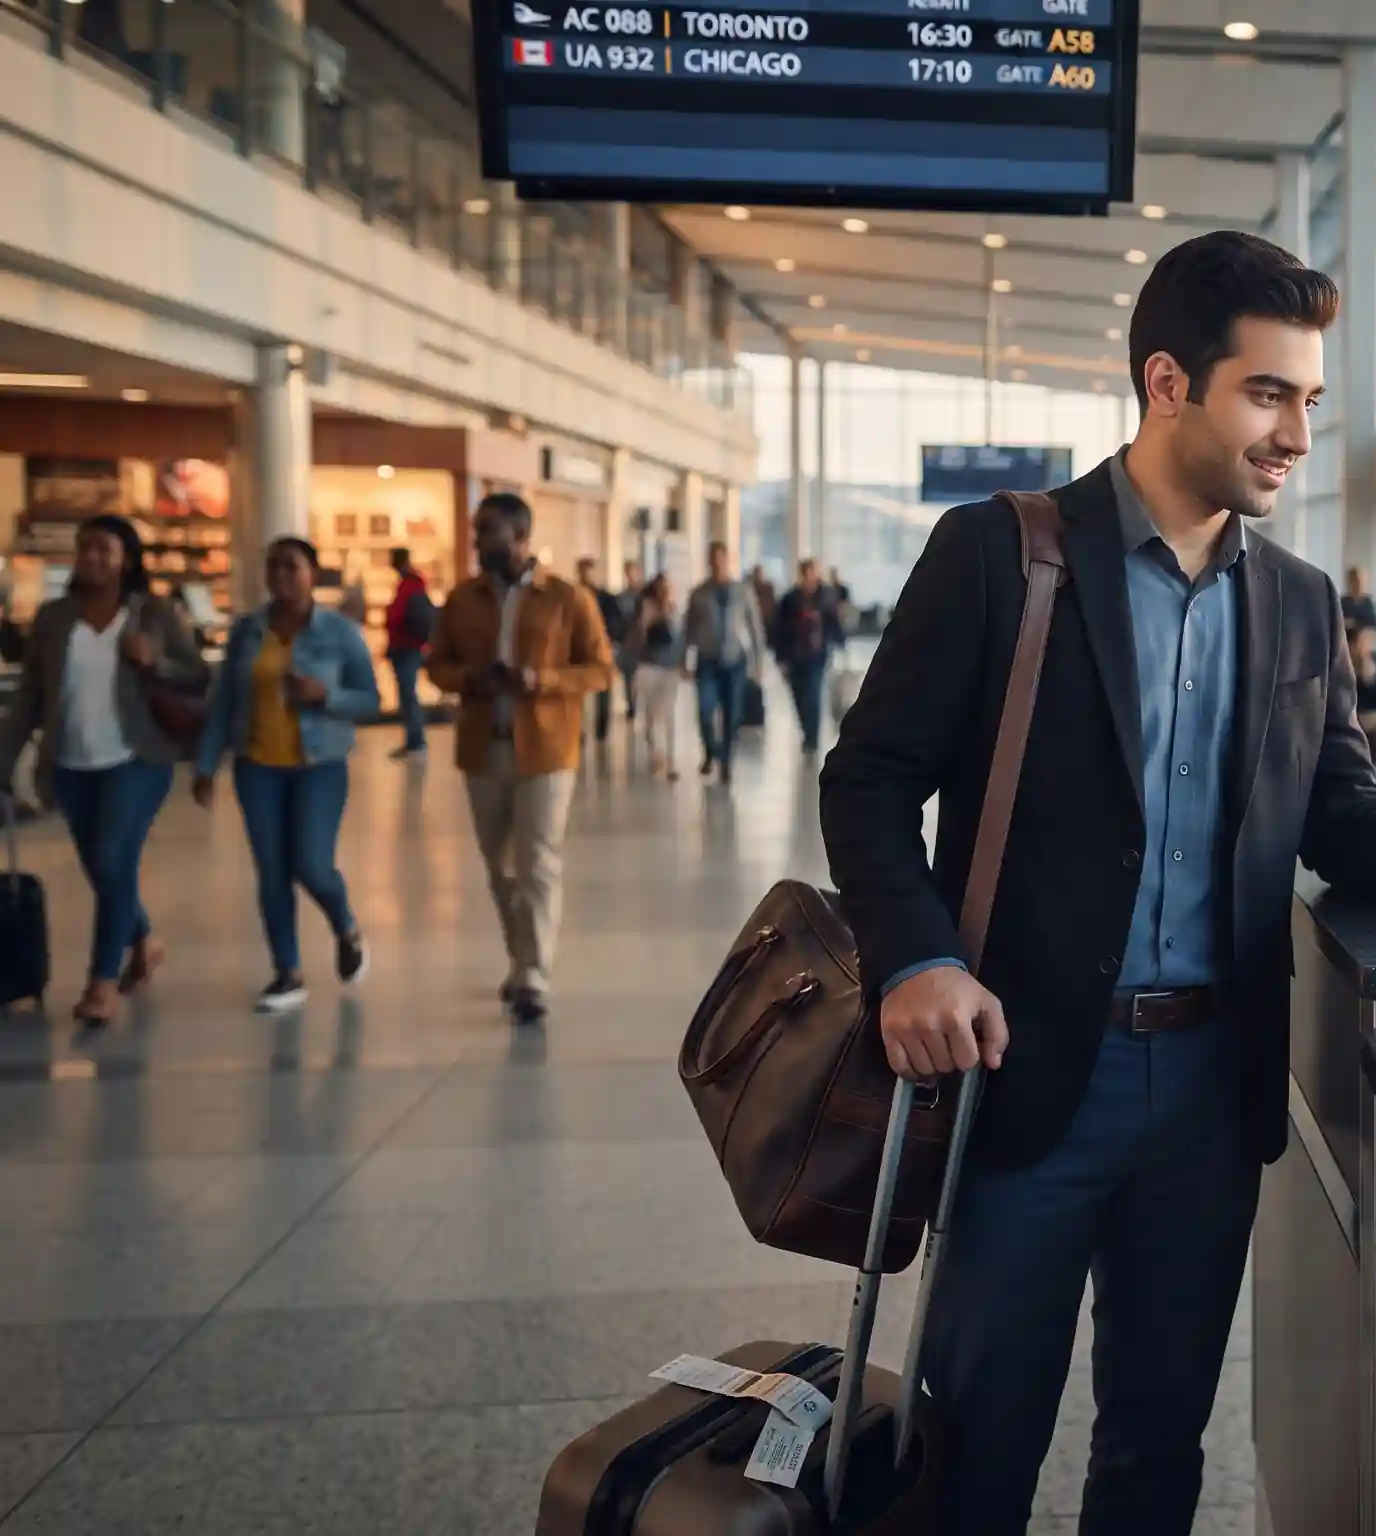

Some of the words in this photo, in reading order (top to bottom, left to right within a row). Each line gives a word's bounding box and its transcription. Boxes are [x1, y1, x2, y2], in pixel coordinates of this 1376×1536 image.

[563, 7, 599, 31] AC
[605, 9, 652, 34] 088
[682, 11, 808, 40] TORONTO
[907, 22, 972, 47] 16:30
[995, 28, 1043, 48] GATE
[1048, 29, 1095, 54] A58
[565, 42, 603, 69] UA
[607, 45, 654, 71] 932
[684, 49, 801, 76] CHICAGO
[908, 58, 972, 83] 17:10
[996, 64, 1043, 83] GATE
[1048, 62, 1095, 89] A60
